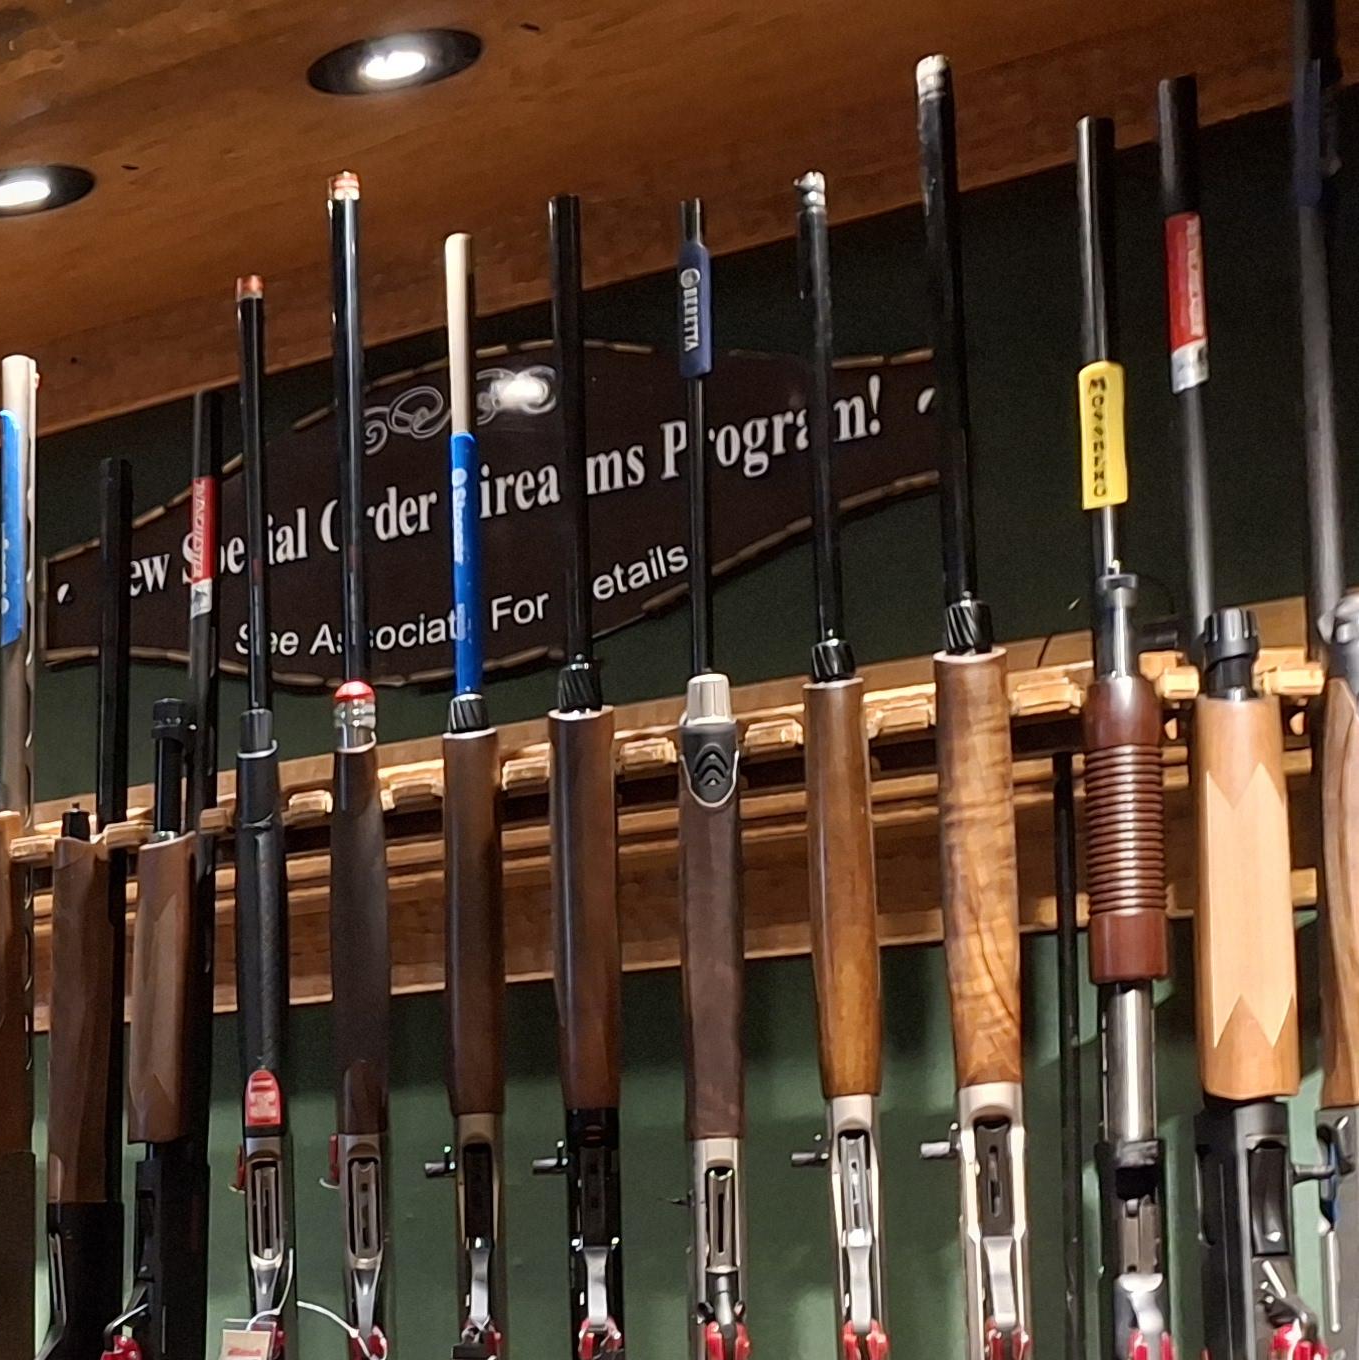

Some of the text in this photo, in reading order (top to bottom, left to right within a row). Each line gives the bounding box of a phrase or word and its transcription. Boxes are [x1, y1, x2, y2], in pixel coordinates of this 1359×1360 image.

[128, 550, 171, 598] ew
[480, 443, 646, 519] ireams
[491, 593, 549, 631] For
[592, 544, 689, 602] etails
